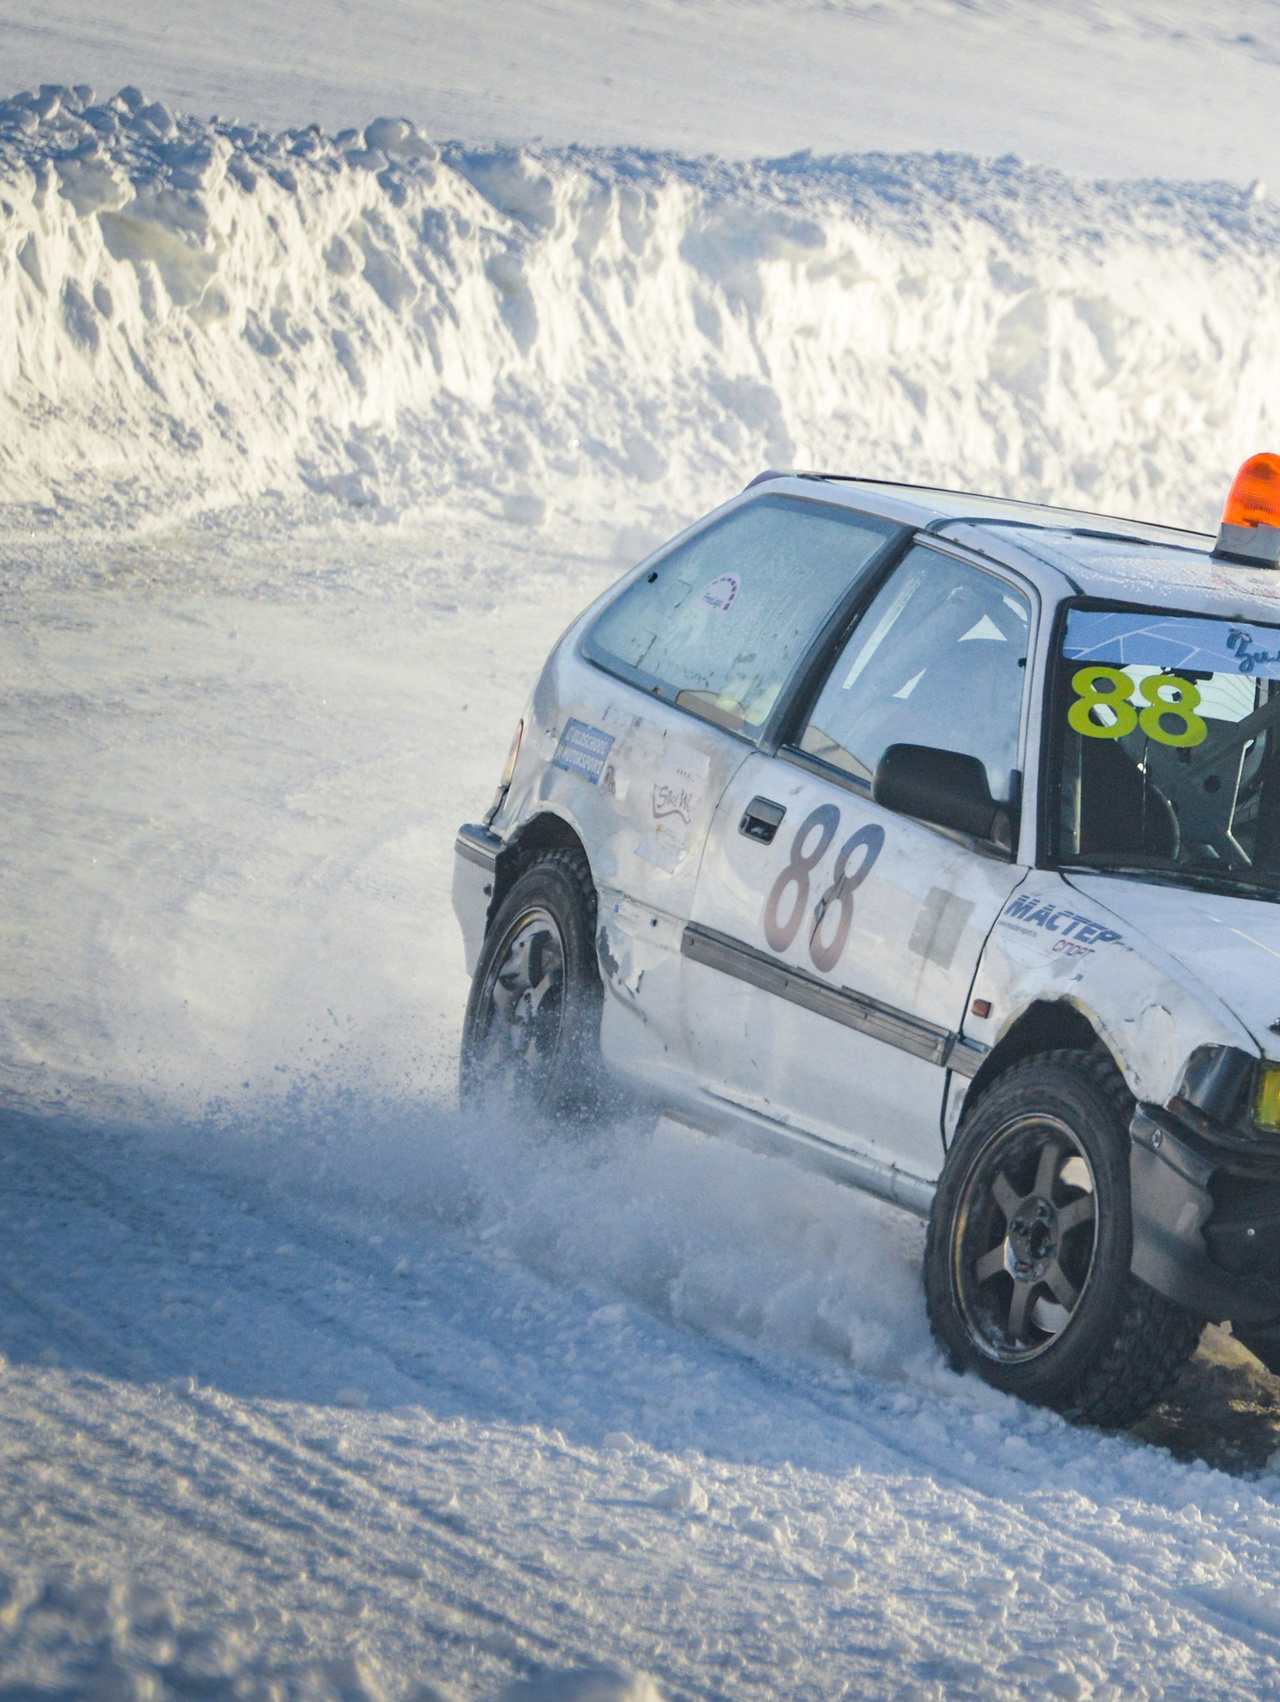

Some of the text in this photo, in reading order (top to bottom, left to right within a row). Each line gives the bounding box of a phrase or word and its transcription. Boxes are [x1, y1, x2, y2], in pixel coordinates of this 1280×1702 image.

[1067, 666, 1208, 747] 88
[763, 803, 886, 974] 88
[1003, 894, 1123, 945] МАСТЕР
[1051, 939, 1096, 959] СПОРТ
